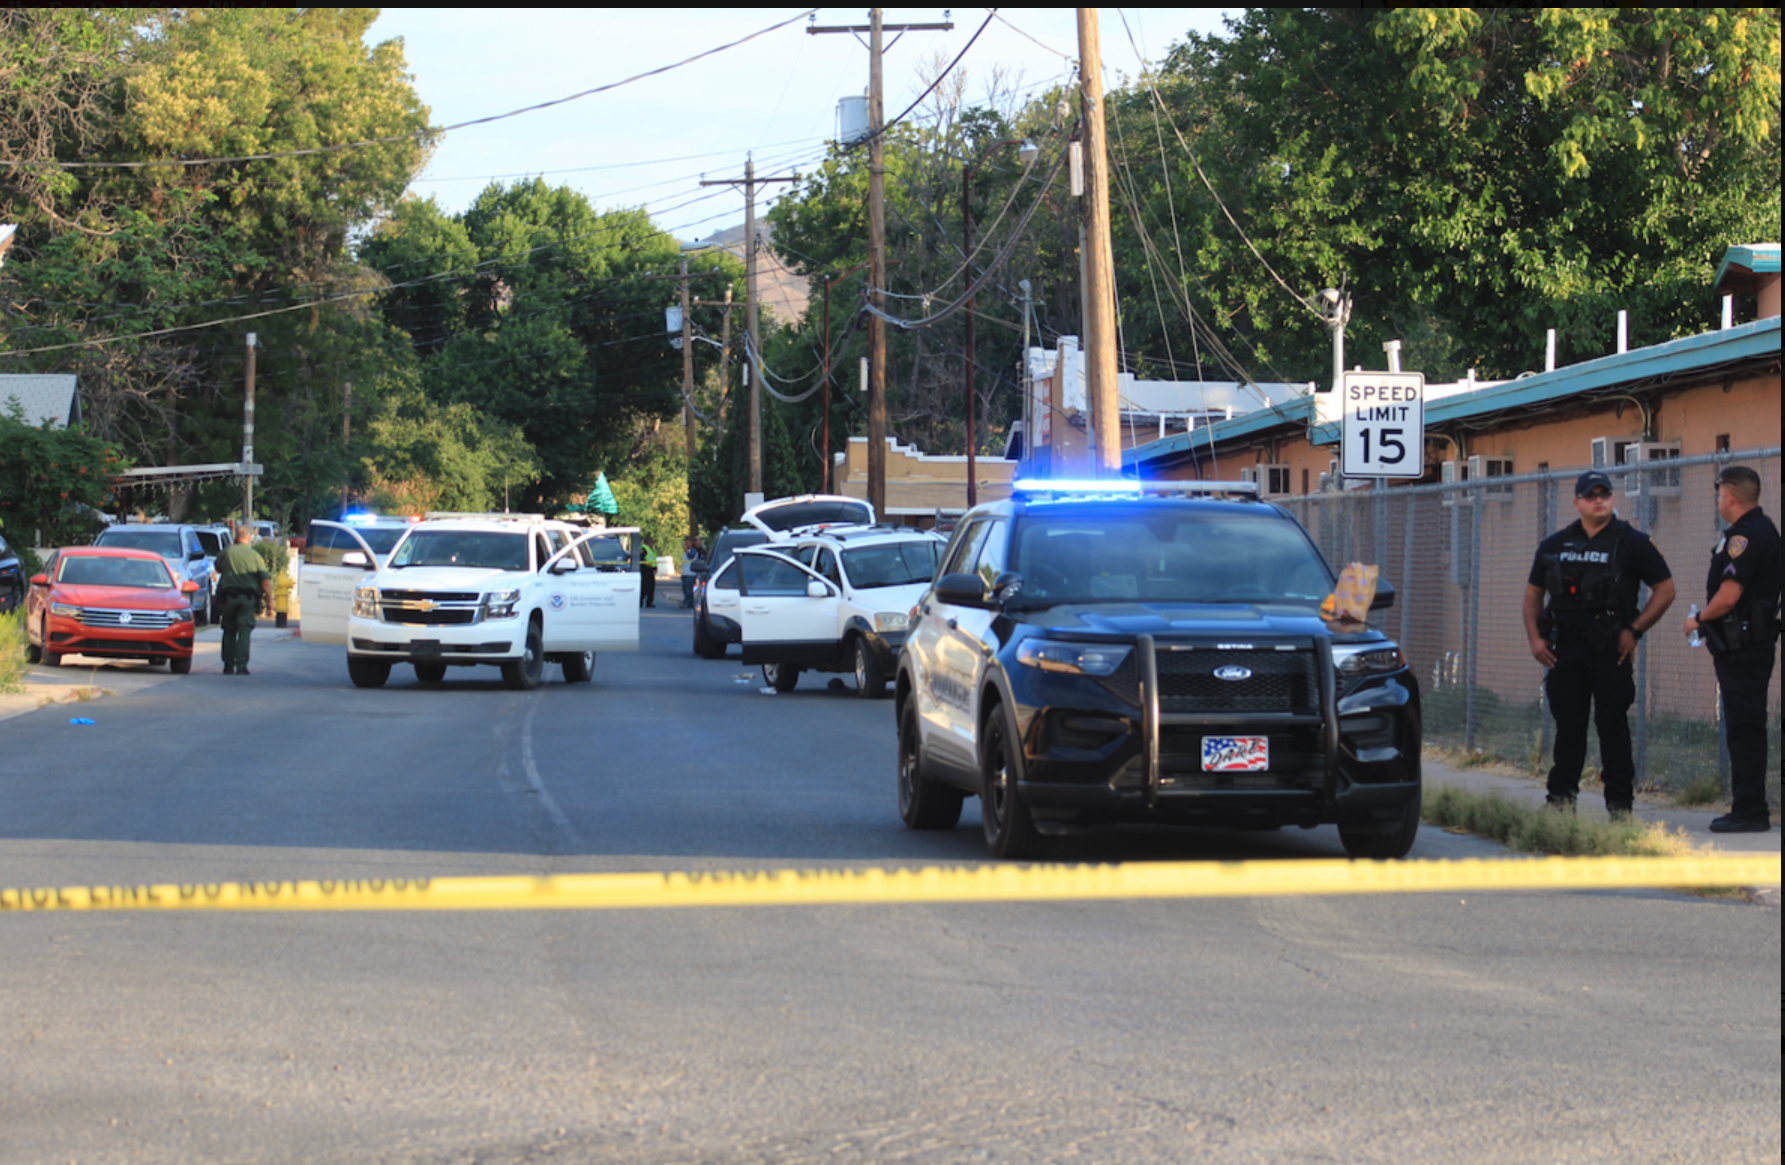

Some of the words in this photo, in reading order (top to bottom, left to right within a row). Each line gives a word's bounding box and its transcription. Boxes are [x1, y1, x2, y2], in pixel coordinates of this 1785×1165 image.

[1350, 385, 1417, 401] SPEED
[1356, 407, 1409, 421] LIMIT
[1359, 428, 1406, 465] 15
[1560, 550, 1609, 563] POLICE
